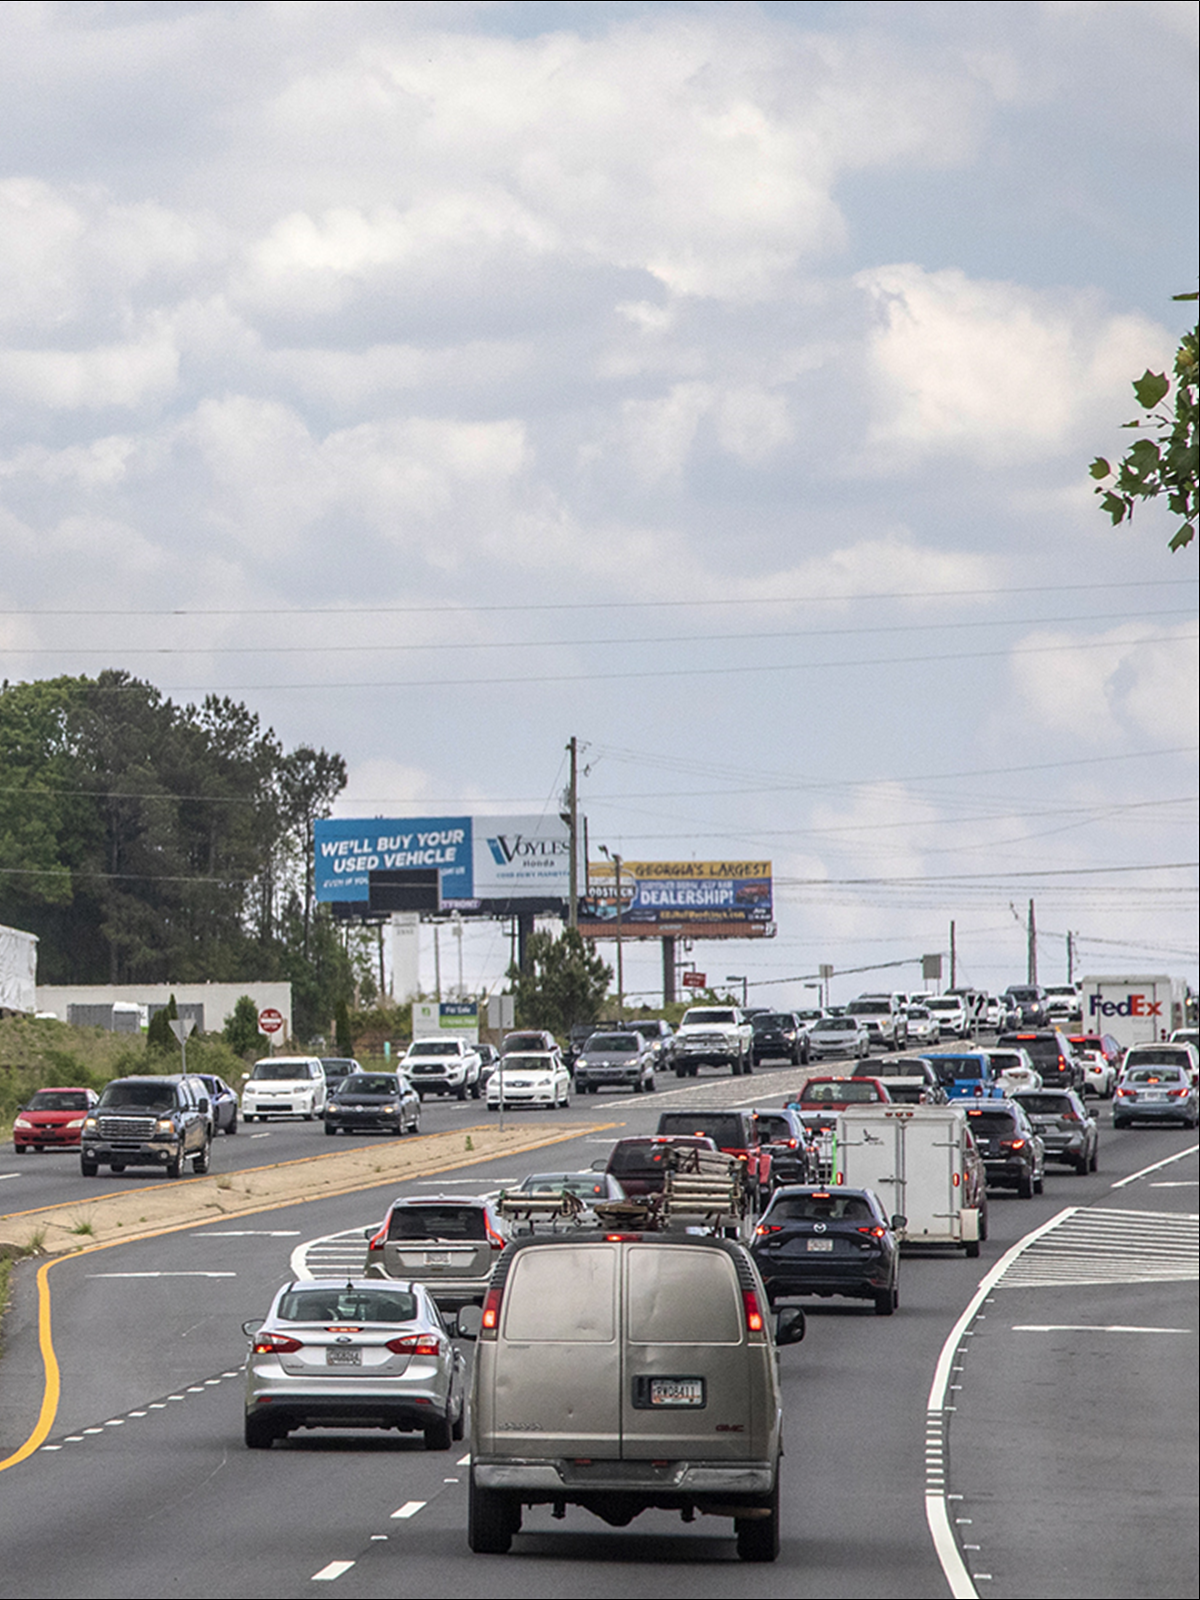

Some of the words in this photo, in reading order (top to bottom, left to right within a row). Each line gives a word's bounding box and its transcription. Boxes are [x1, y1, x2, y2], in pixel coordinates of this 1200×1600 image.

[321, 837, 373, 857] WE'LL
[377, 833, 414, 851] BUY
[416, 829, 464, 846] YOUR
[333, 855, 379, 874] USED
[383, 847, 457, 868] VEHICLE
[523, 859, 555, 868] Honda
[636, 863, 703, 877] GEORGIA'S
[709, 863, 768, 877] LARGEST
[640, 889, 734, 905] DEALERSHIP!
[1089, 994, 1163, 1017] FedEx
